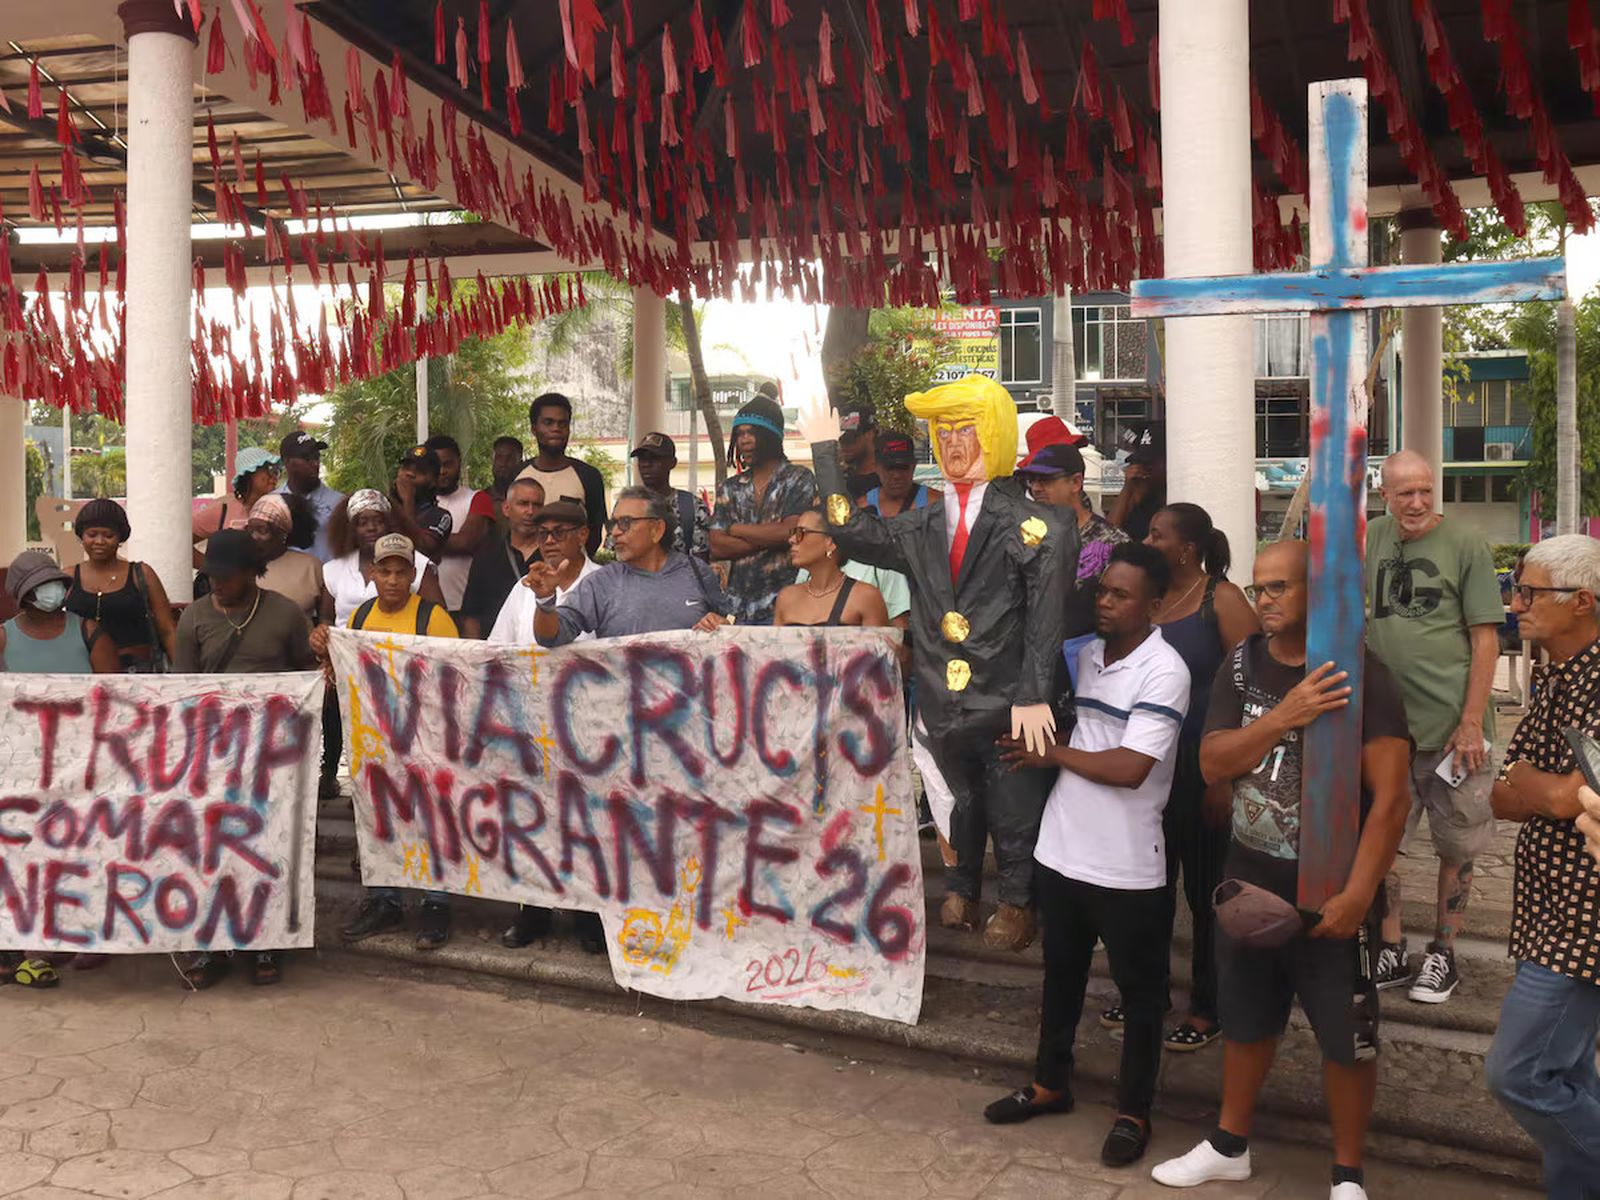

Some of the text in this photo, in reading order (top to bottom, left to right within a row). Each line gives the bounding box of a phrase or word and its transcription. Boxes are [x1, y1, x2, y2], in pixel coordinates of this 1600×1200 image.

[12, 684, 314, 802] TRUMP
[0, 796, 280, 876] COMAR
[0, 855, 273, 947] NERON
[744, 946, 830, 993] 2026
